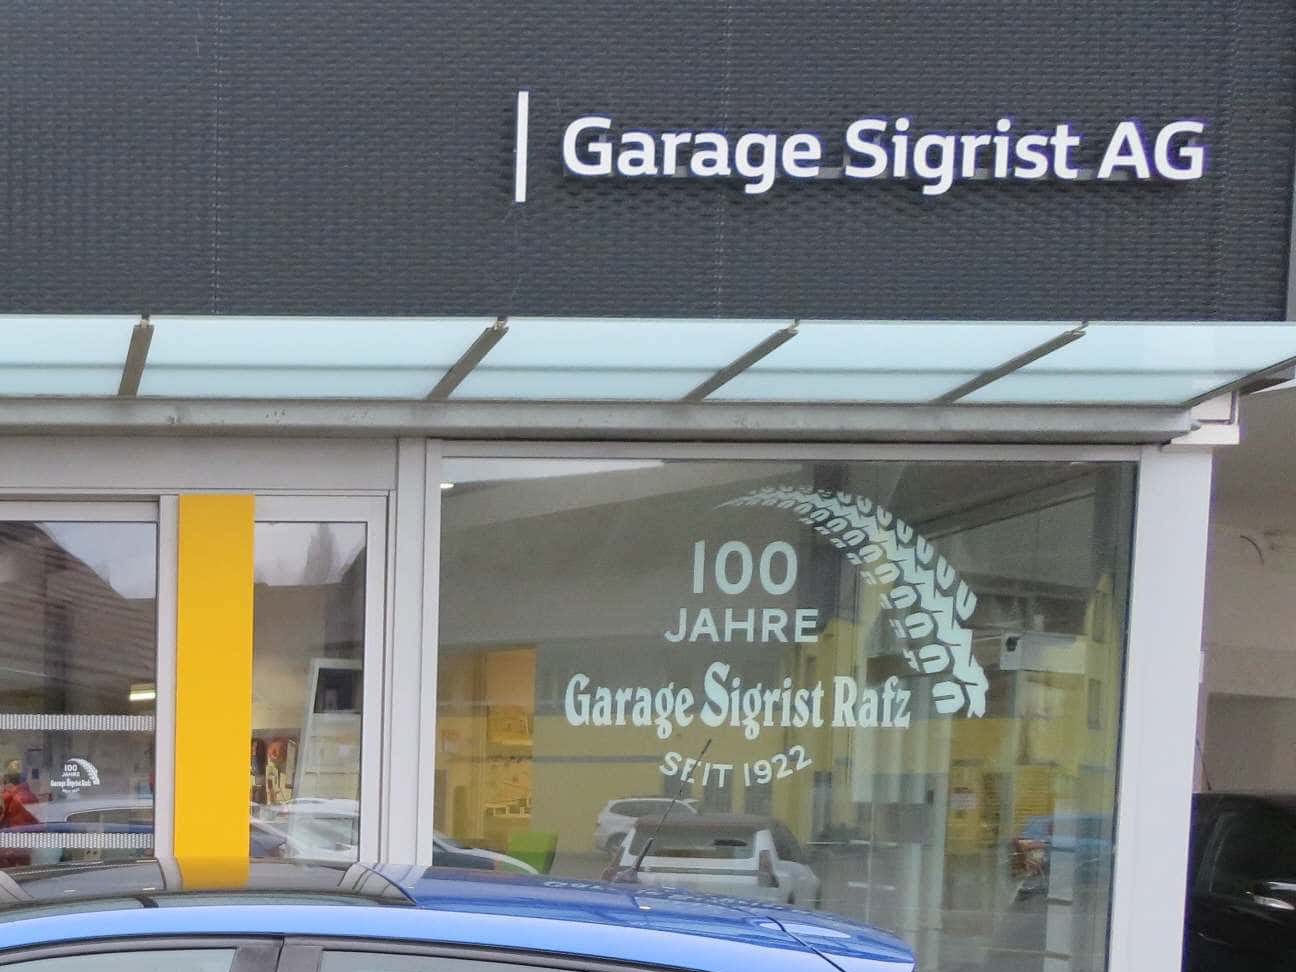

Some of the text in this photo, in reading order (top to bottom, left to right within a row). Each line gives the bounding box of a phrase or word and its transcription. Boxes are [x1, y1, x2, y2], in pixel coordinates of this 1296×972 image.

[561, 115, 1206, 196] Garage Sigrist AG
[692, 540, 798, 596] 100
[664, 608, 820, 644] JAHRE
[564, 661, 912, 740] Garage Sigrist Rafz
[658, 744, 814, 789] SEIT 1922
